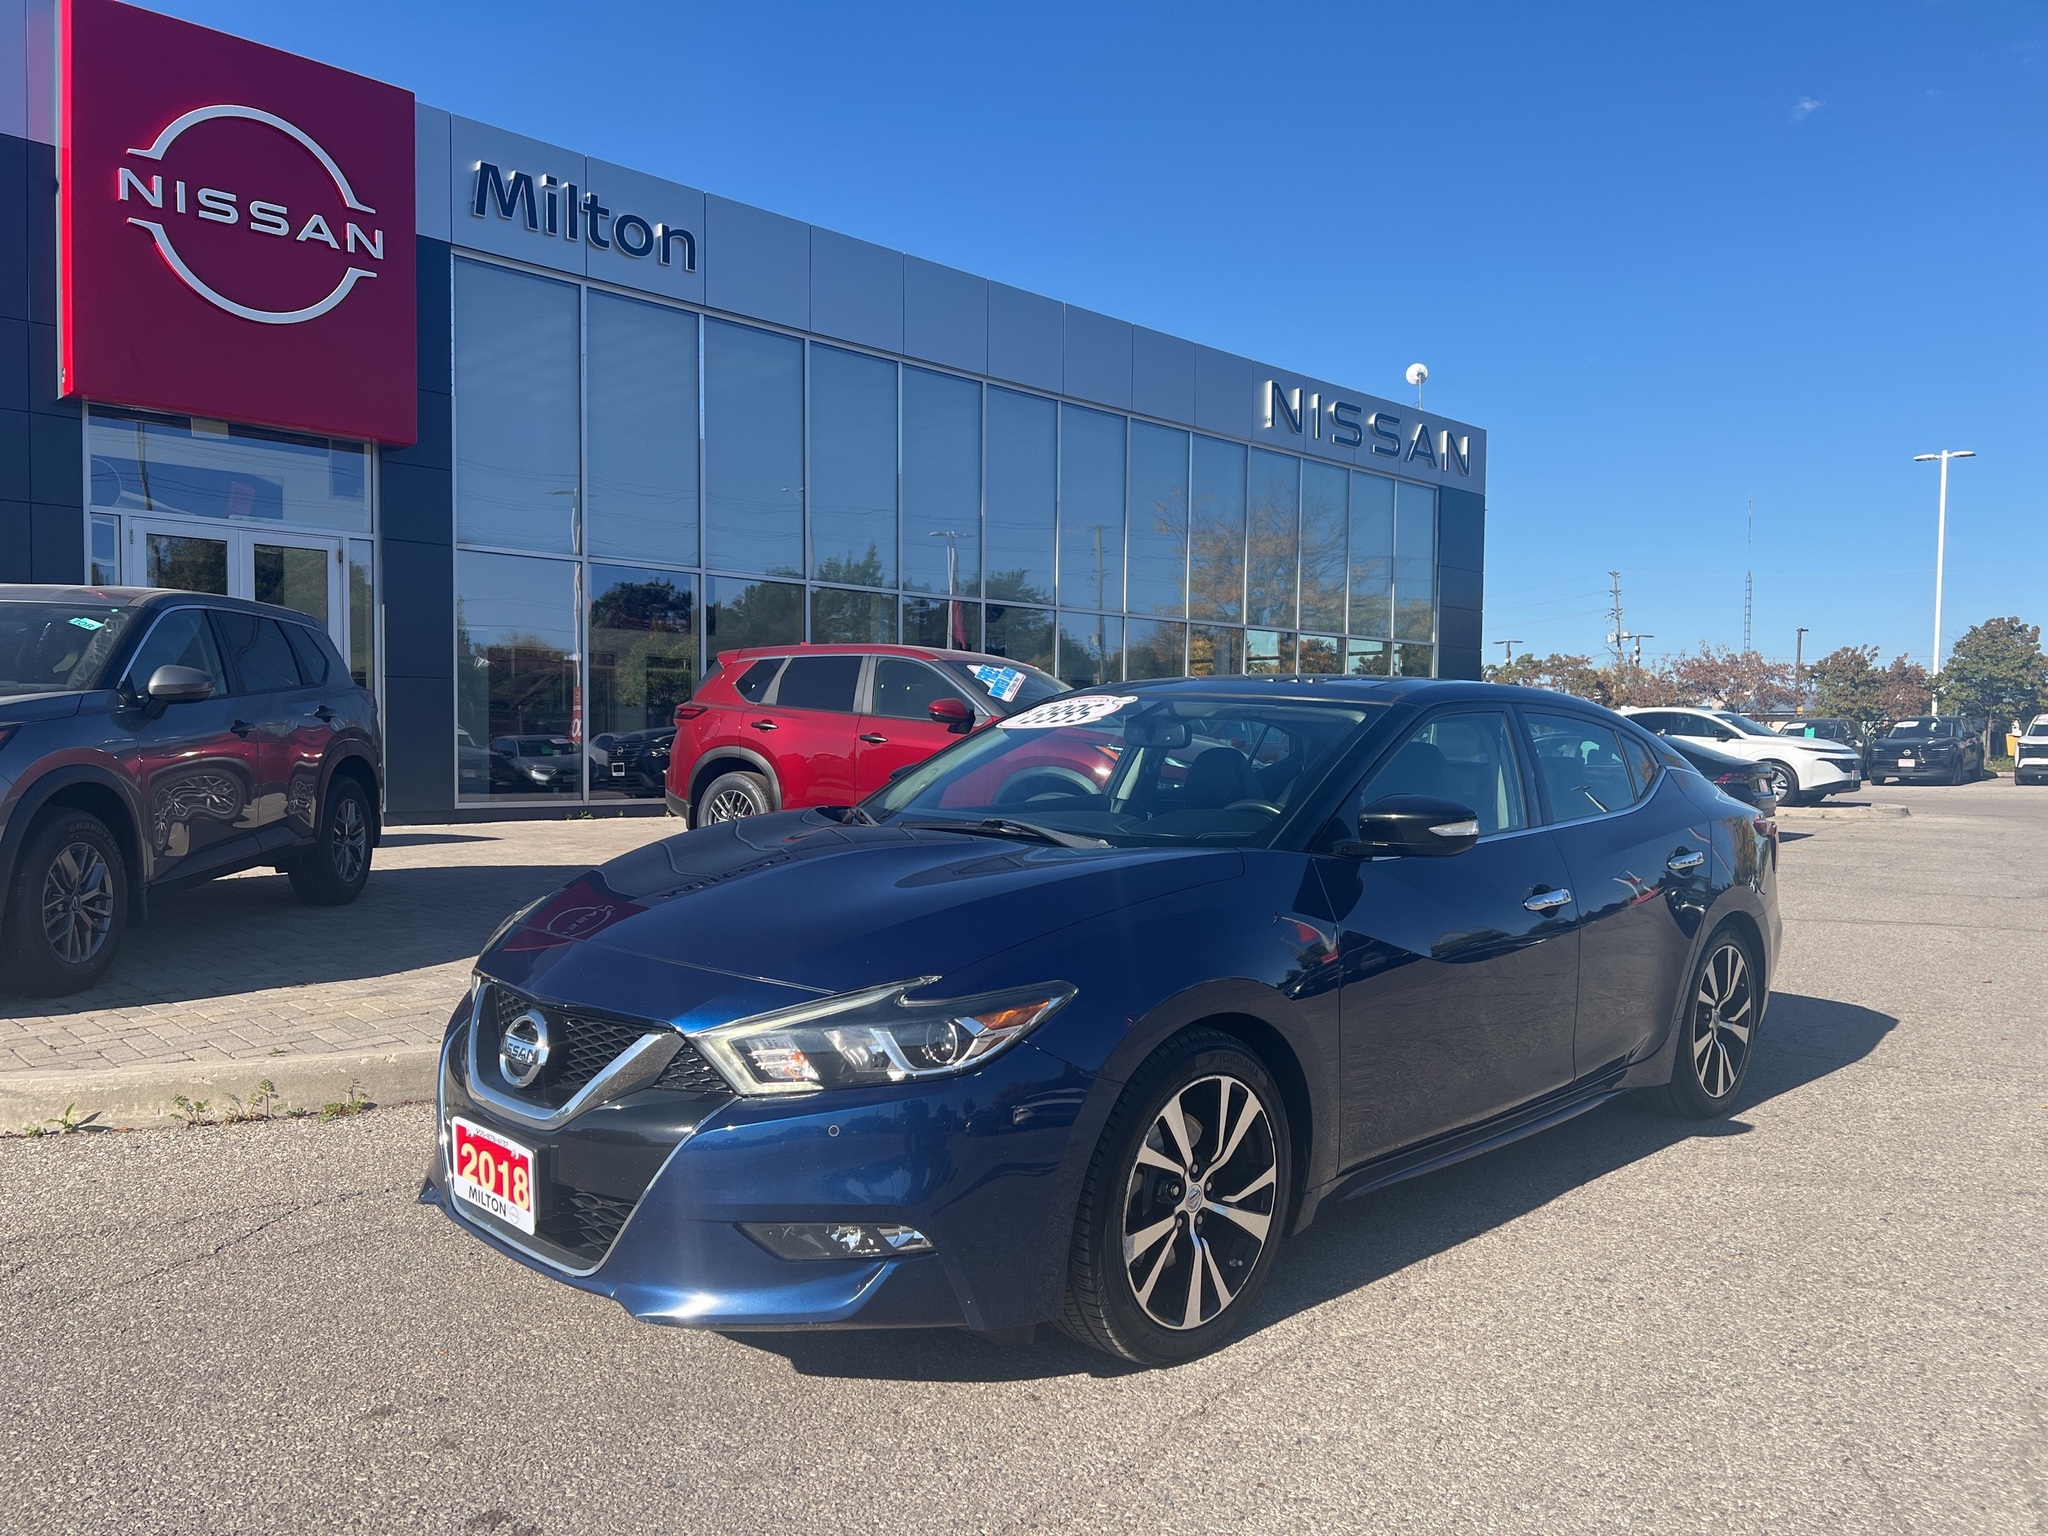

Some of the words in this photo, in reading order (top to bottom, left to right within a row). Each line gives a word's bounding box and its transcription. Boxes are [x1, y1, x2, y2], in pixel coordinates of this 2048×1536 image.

[118, 167, 383, 260] NISSAN
[473, 160, 697, 272] Milton
[1265, 380, 1470, 476] NISSAN
[1218, 1051, 1259, 1078] YOKOHAMA
[460, 1142, 529, 1211] 2018
[468, 1185, 507, 1218] MILTON
